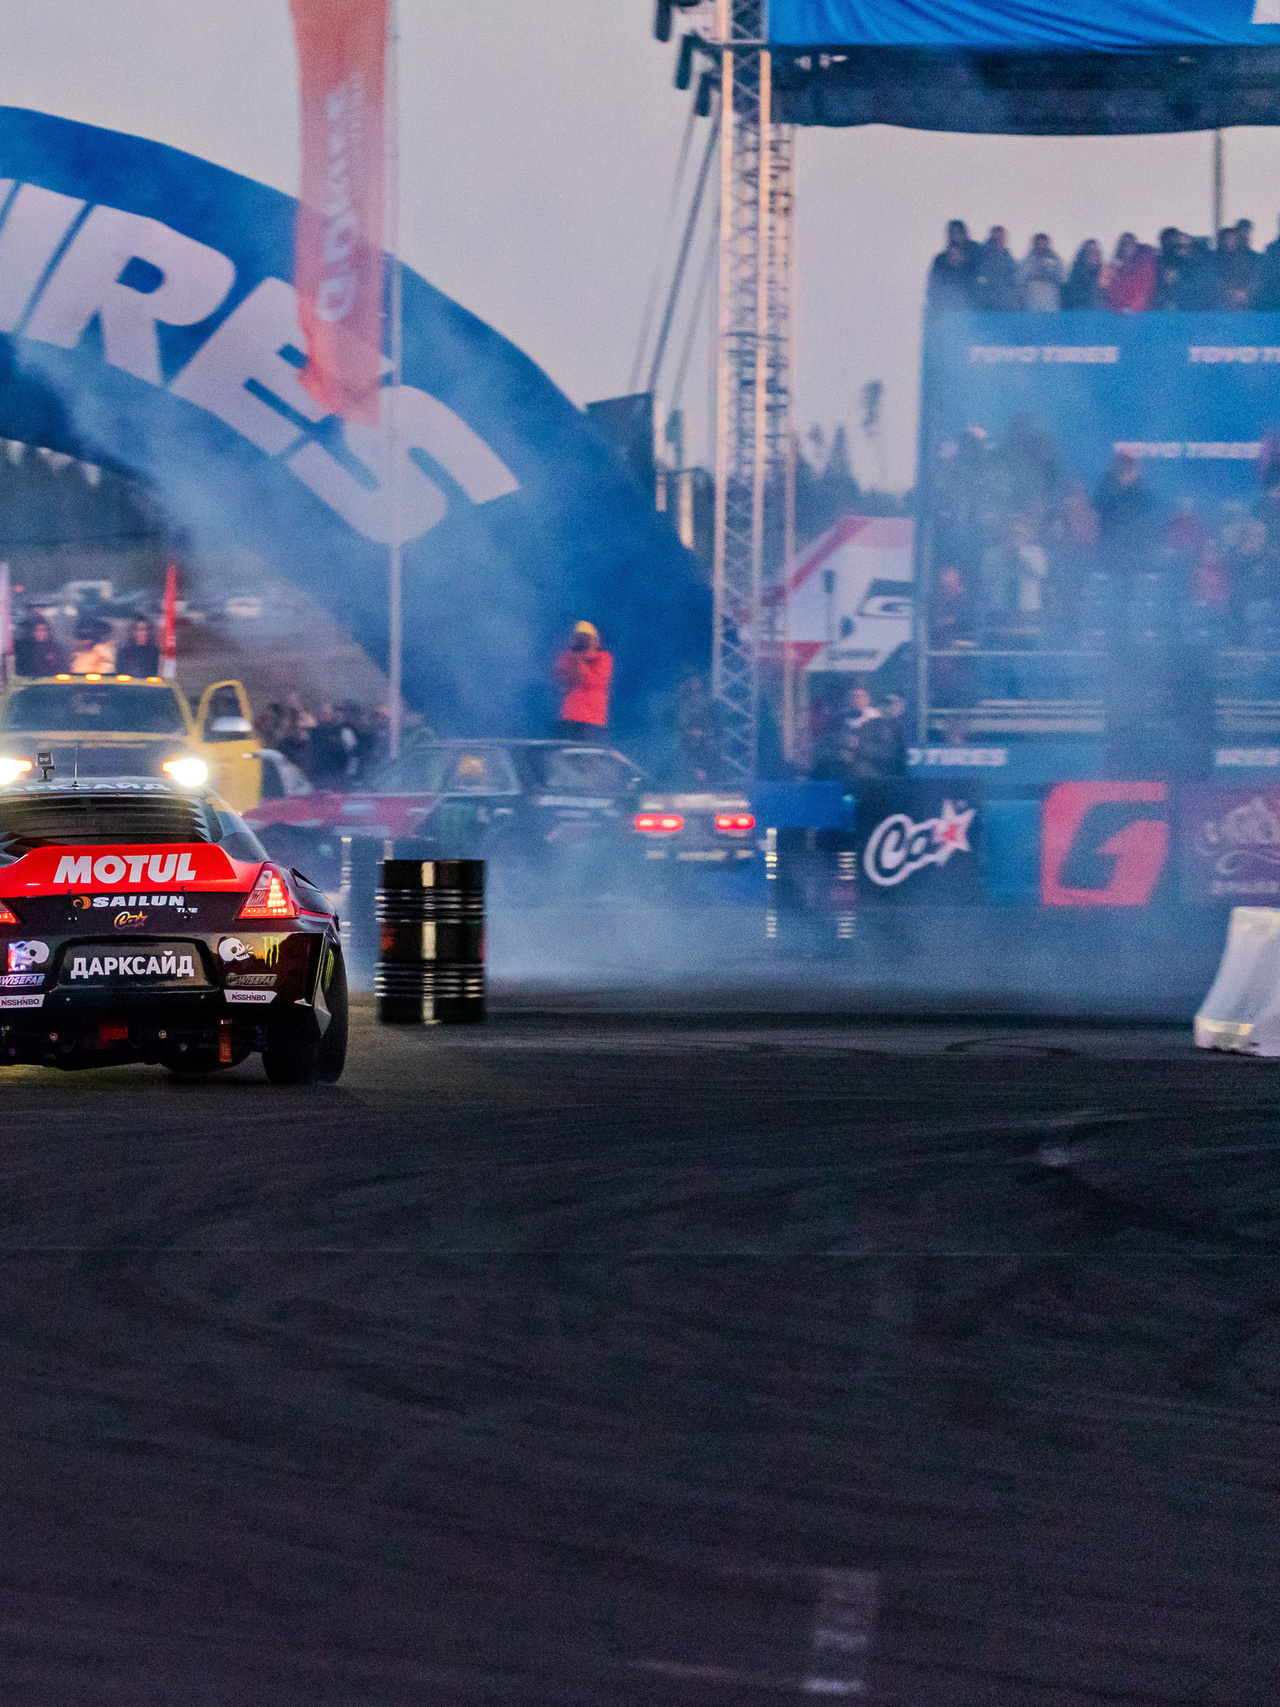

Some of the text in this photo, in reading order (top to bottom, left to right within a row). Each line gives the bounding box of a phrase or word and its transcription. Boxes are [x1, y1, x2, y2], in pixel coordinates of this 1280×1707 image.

[53, 853, 196, 884] MOTUL
[92, 895, 185, 908] SAILUN
[70, 951, 194, 979] ДАРКСАЙД
